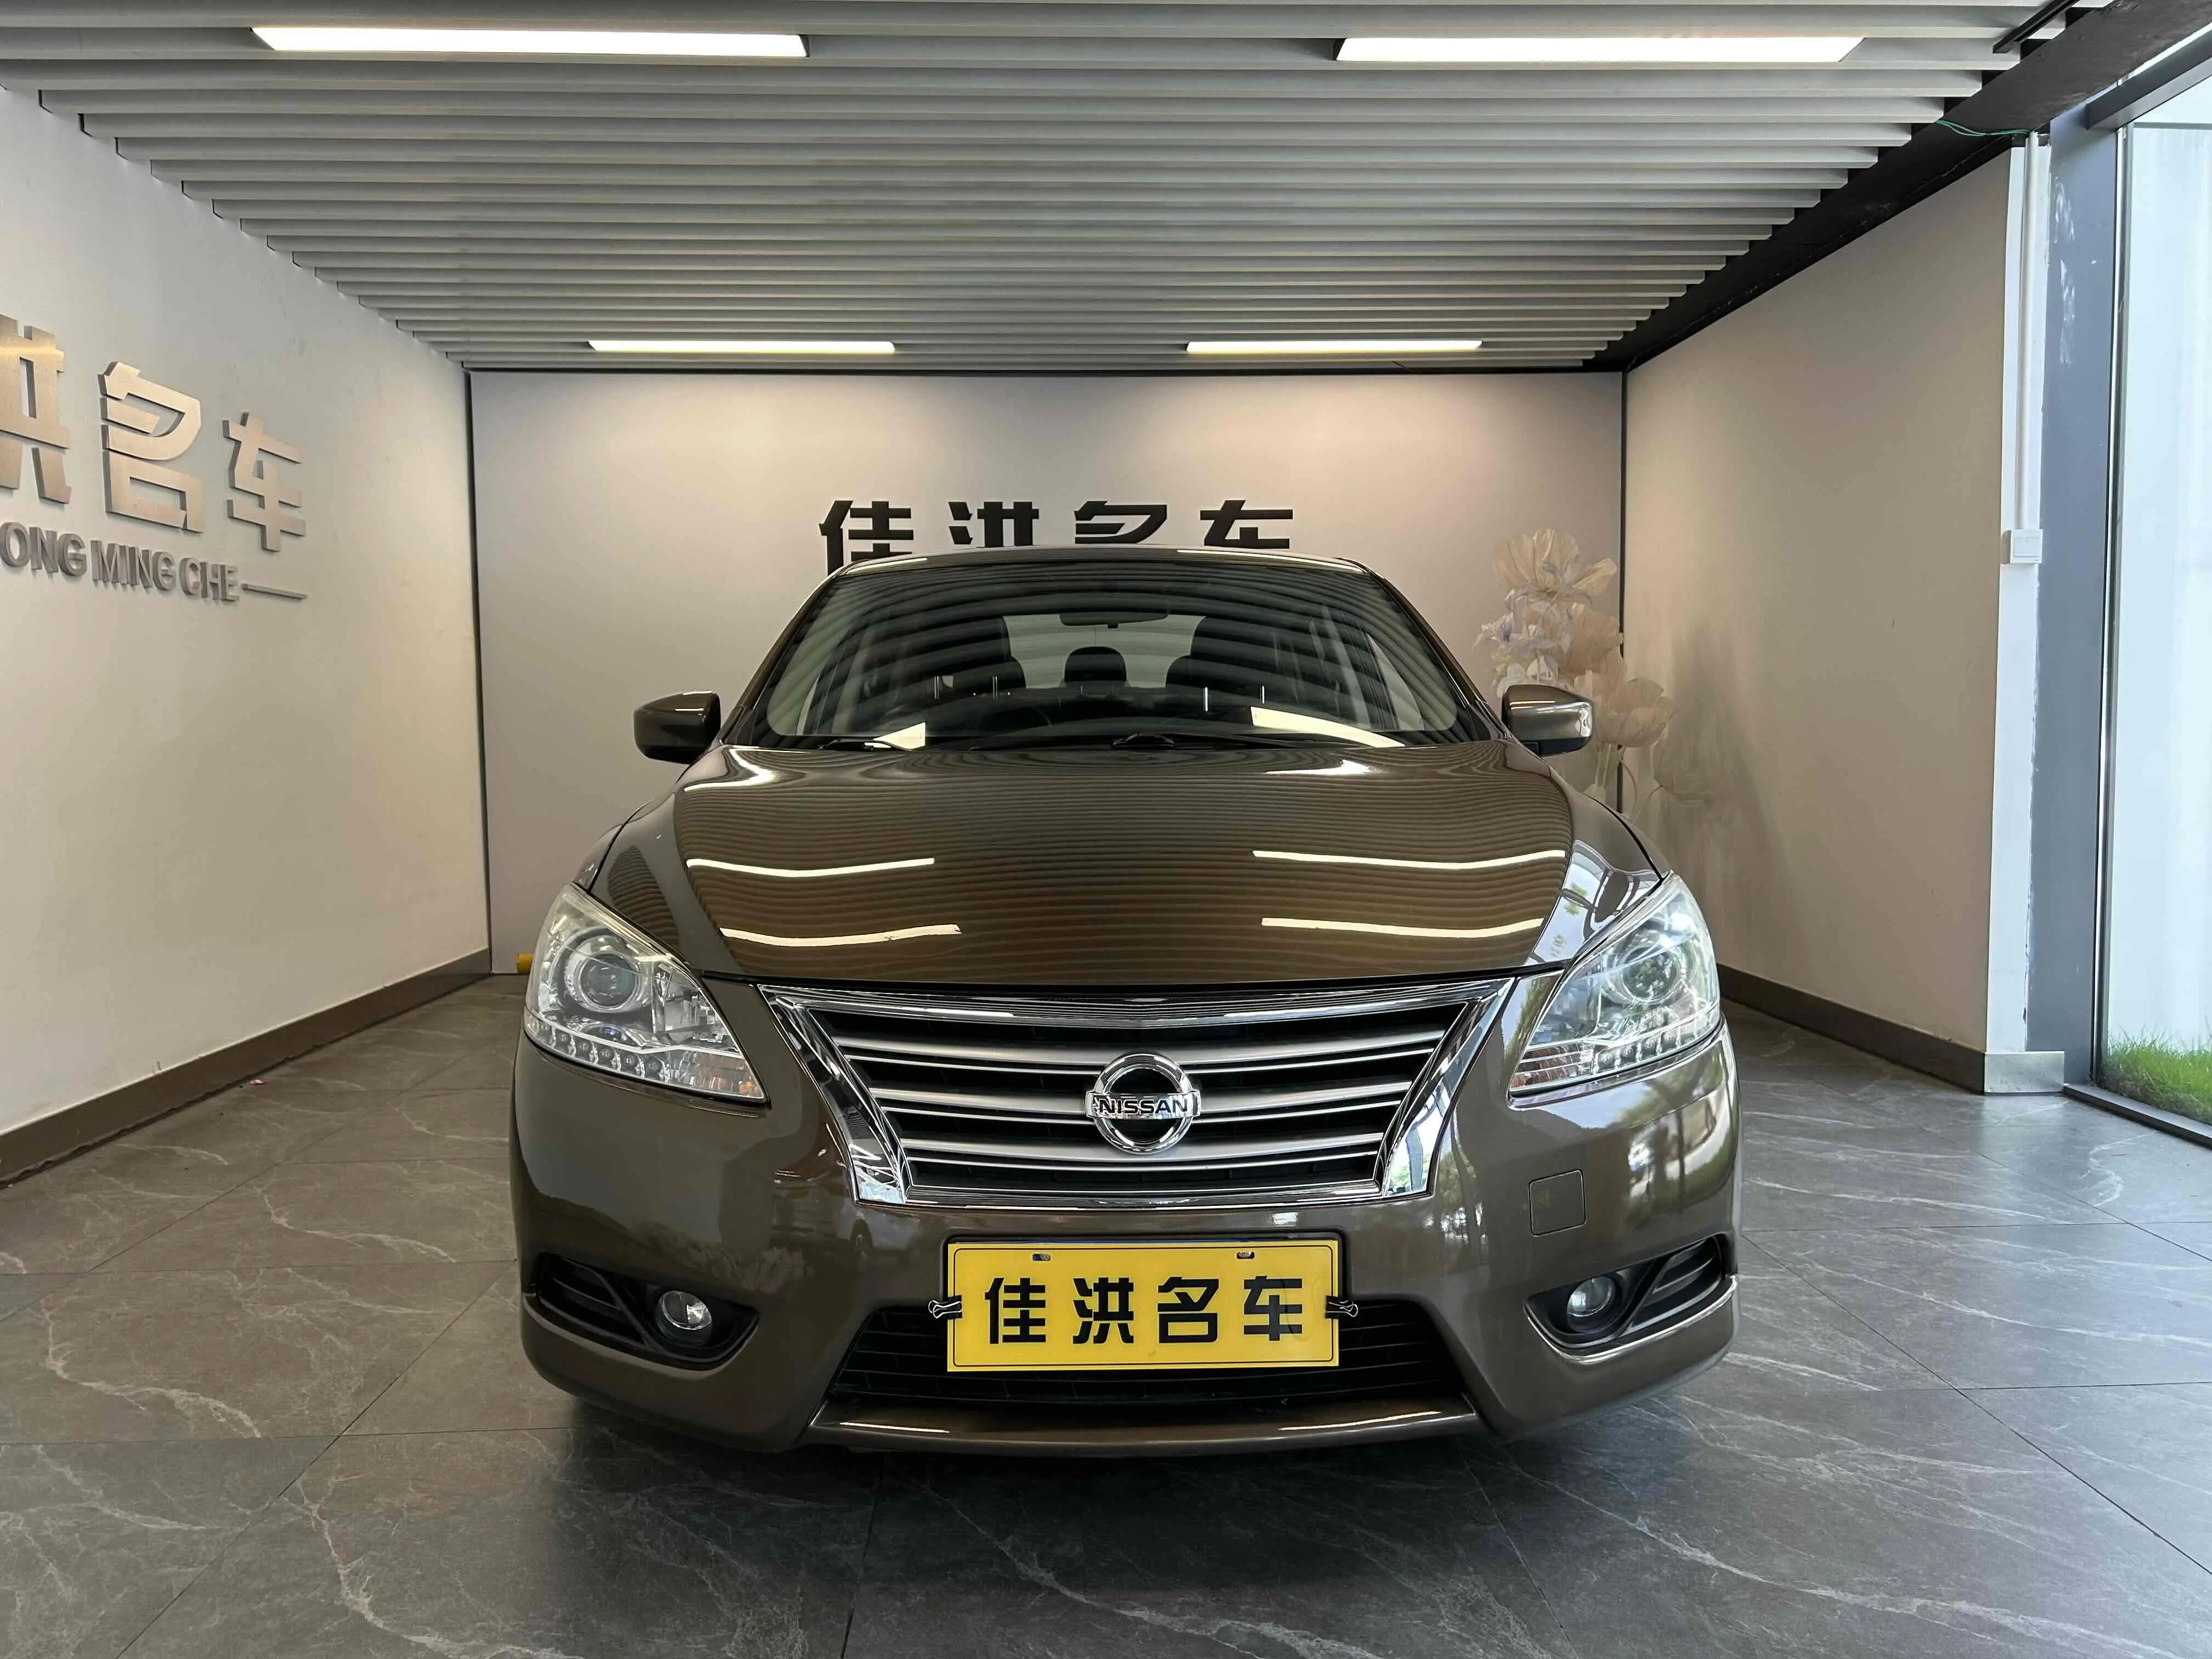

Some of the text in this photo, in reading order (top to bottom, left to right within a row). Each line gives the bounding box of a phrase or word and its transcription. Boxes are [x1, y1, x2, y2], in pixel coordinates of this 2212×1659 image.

[91, 540, 177, 591] MING
[179, 557, 239, 601] CHE
[1099, 1099, 1188, 1114] NISSAN
[985, 1276, 1303, 1344] 佳洪名车
